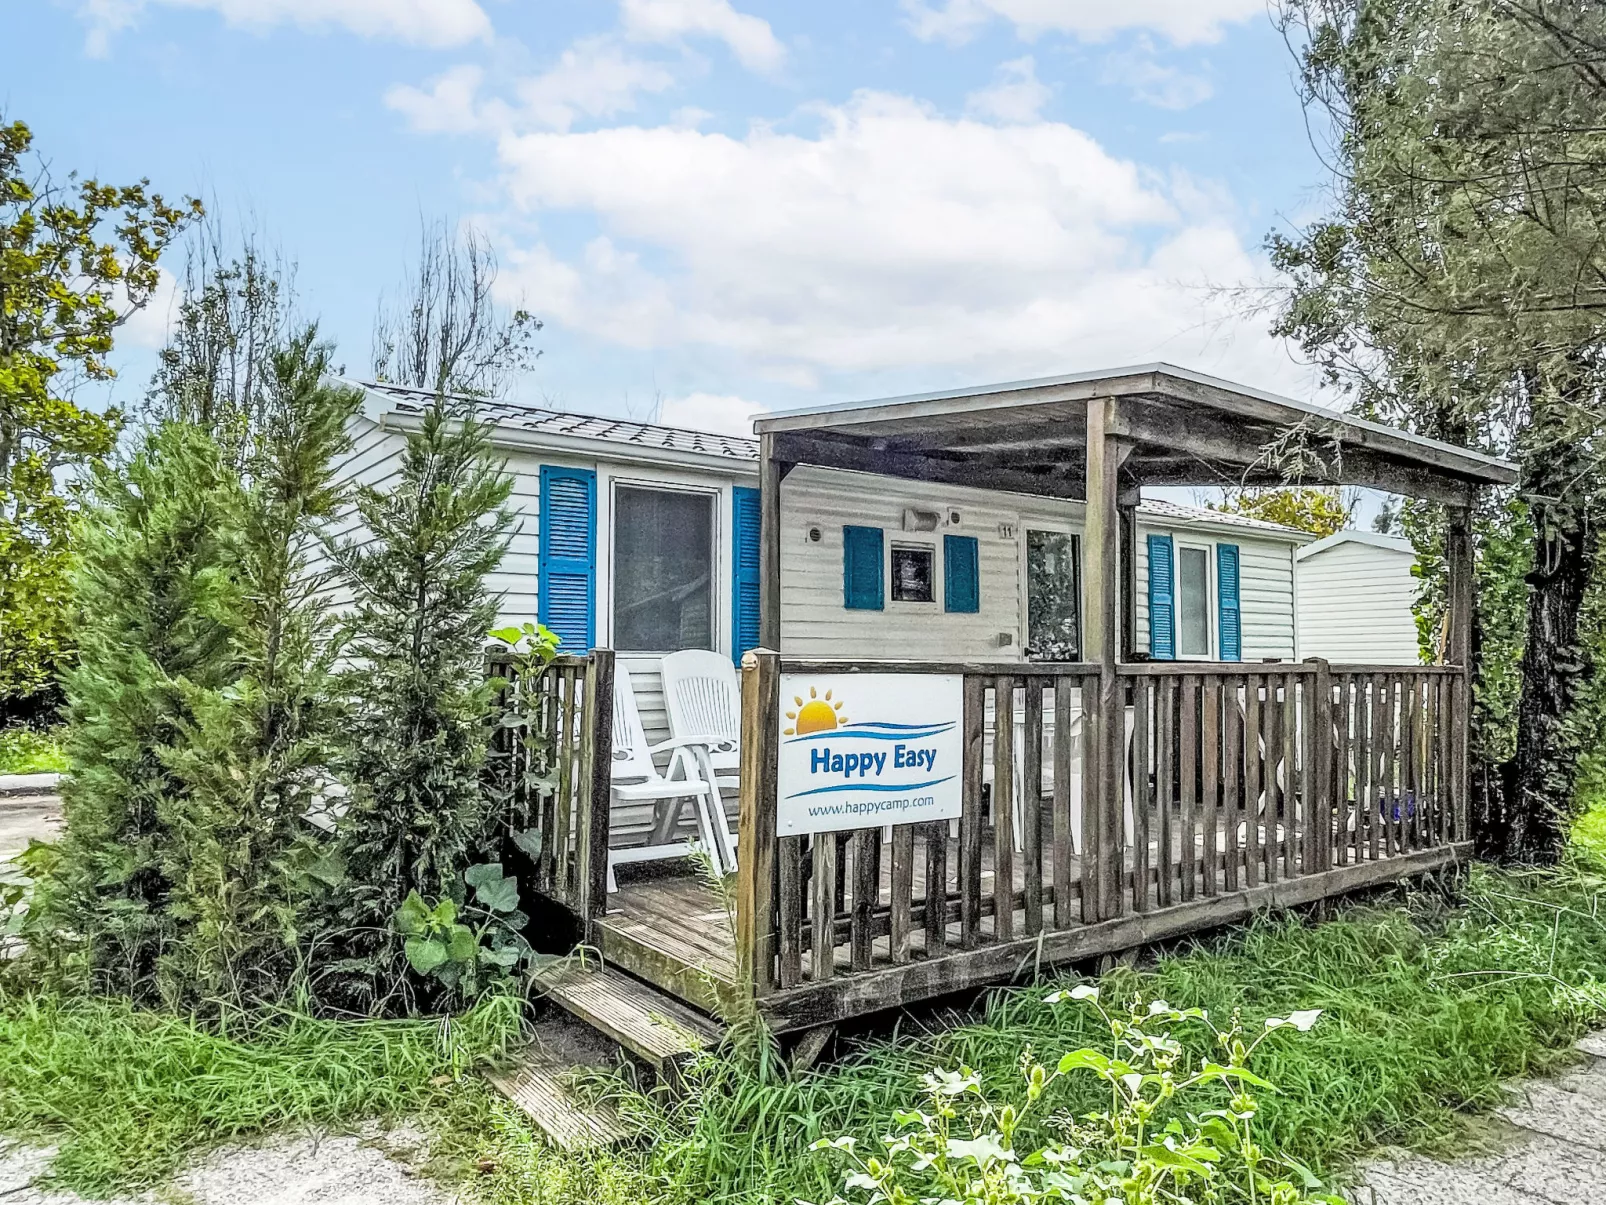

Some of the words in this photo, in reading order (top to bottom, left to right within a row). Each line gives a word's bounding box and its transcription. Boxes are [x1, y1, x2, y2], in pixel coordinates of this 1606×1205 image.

[1002, 525, 1012, 538] 11
[810, 747, 887, 778] Happy
[893, 744, 937, 772] Easy
[808, 796, 934, 817] www.happycamp.com
